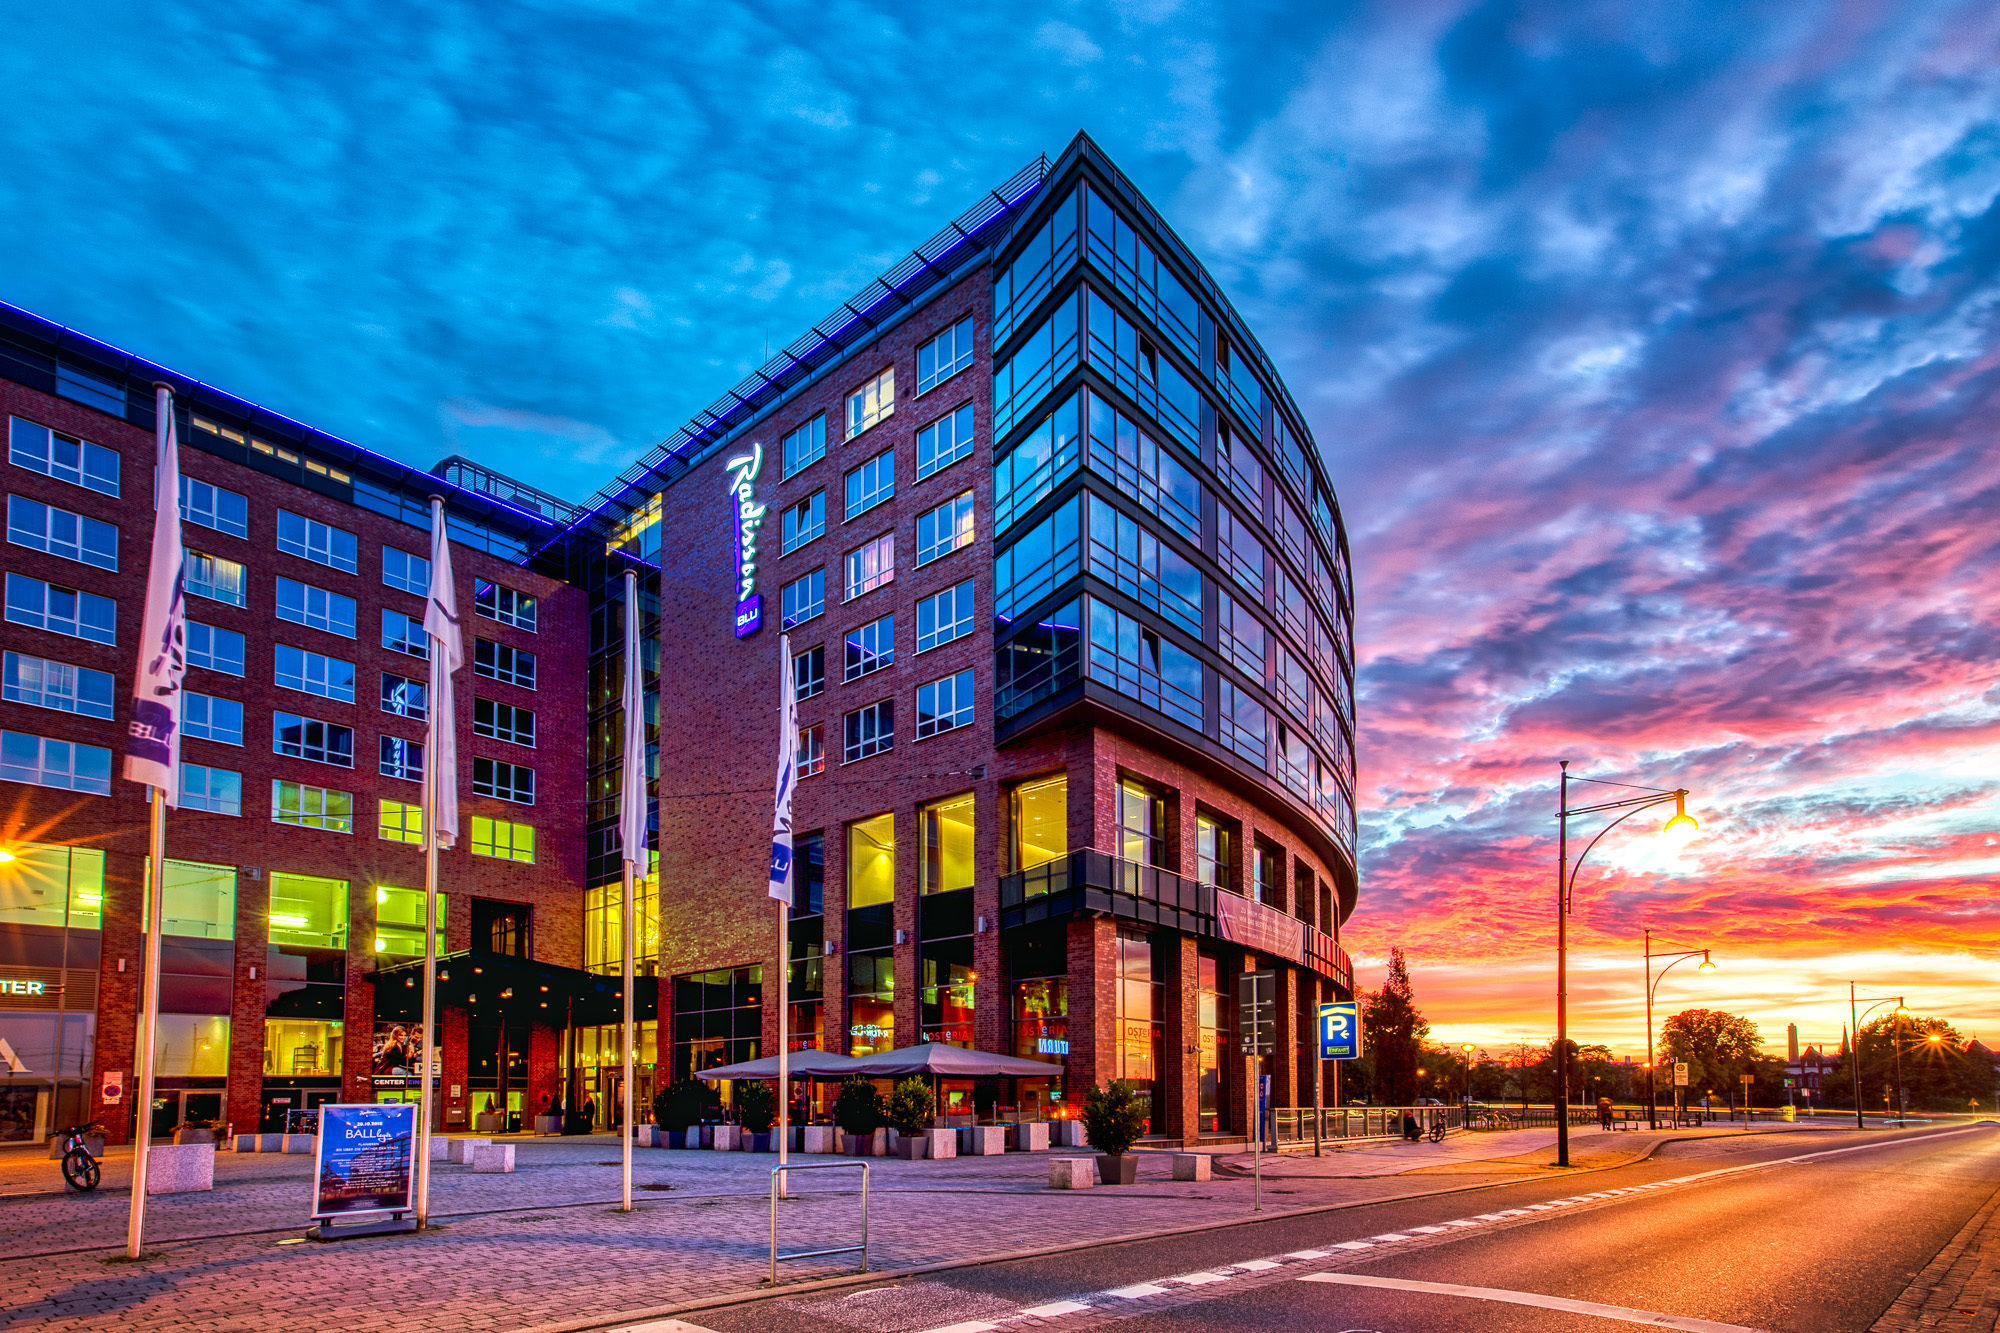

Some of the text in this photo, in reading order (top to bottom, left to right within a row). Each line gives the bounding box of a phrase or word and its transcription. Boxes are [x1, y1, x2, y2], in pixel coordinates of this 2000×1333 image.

[726, 442, 766, 602] Radisson
[737, 608, 758, 627] BLU
[1327, 1015, 1348, 1040] P
